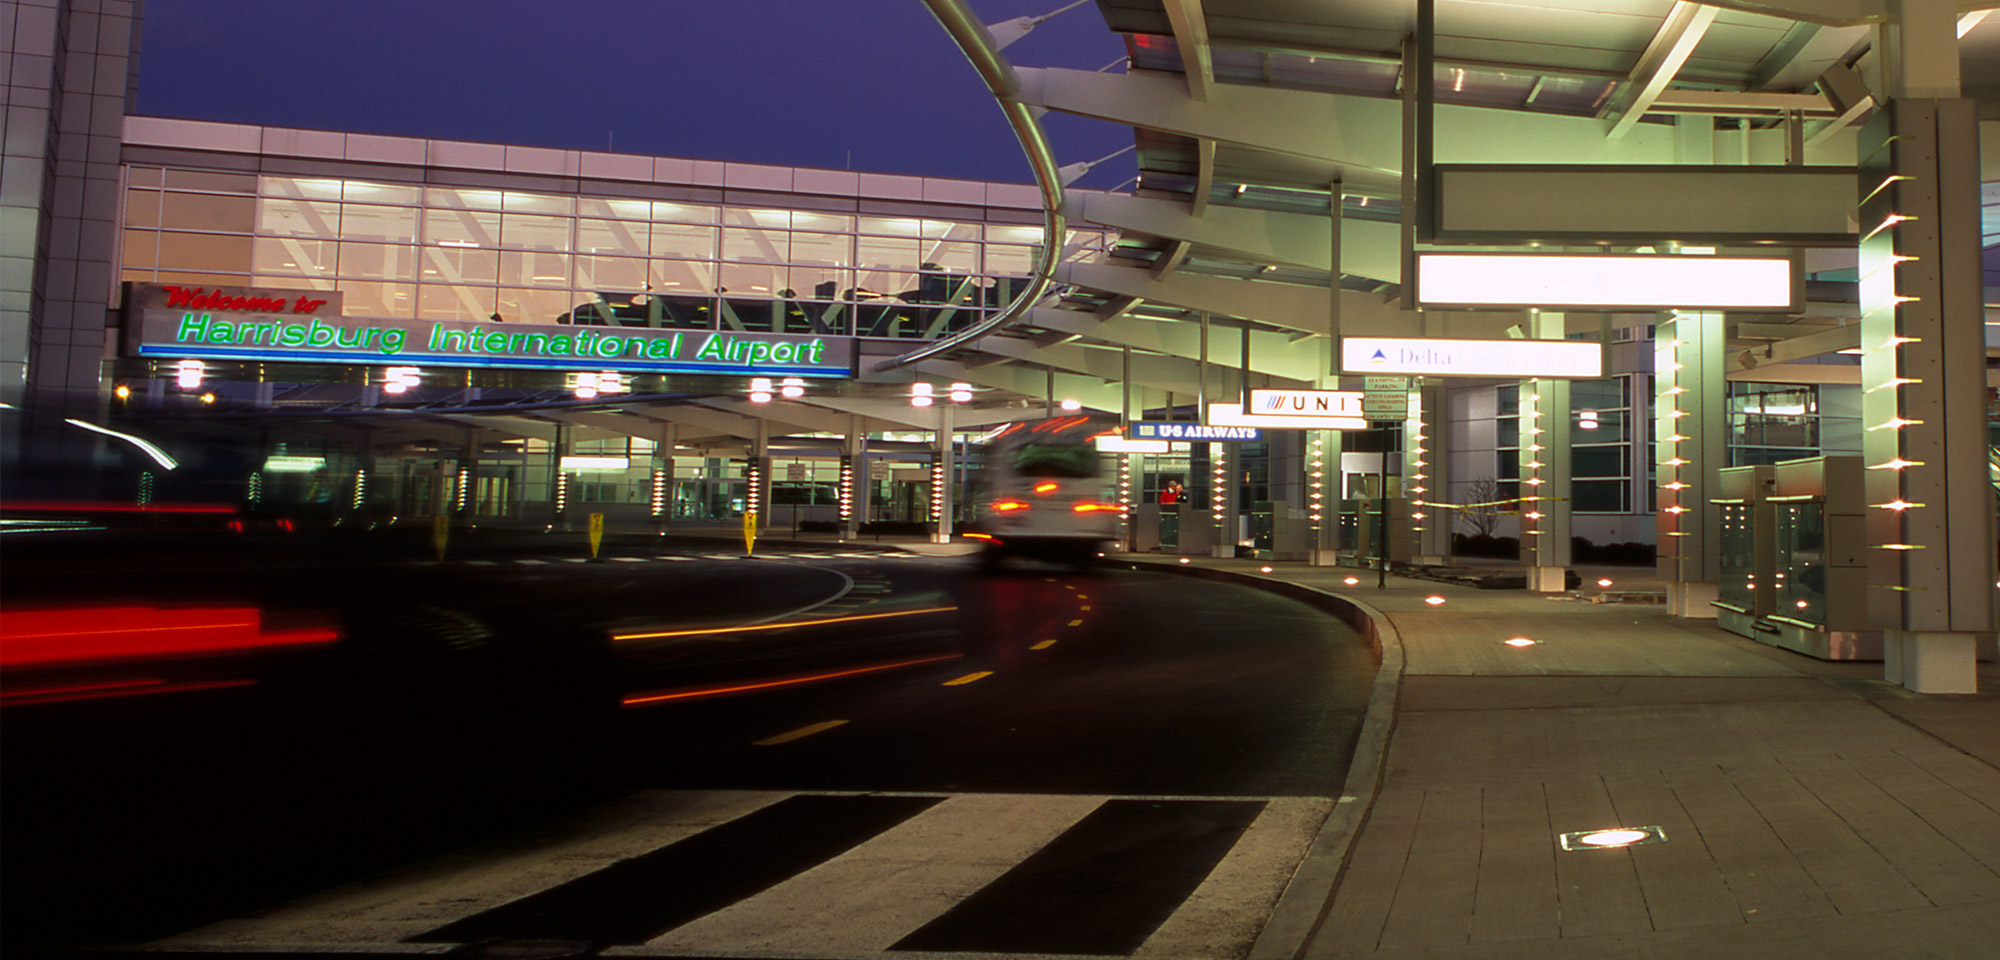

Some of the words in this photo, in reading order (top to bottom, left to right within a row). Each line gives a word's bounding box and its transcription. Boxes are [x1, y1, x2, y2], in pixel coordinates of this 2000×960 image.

[163, 285, 286, 312] Welcome
[293, 295, 327, 313] to
[177, 313, 406, 354] Harrisburg
[428, 322, 684, 359] International
[696, 333, 825, 366] Airport
[1400, 348, 1452, 365] Delta
[1184, 425, 1256, 439] AIRWAYS
